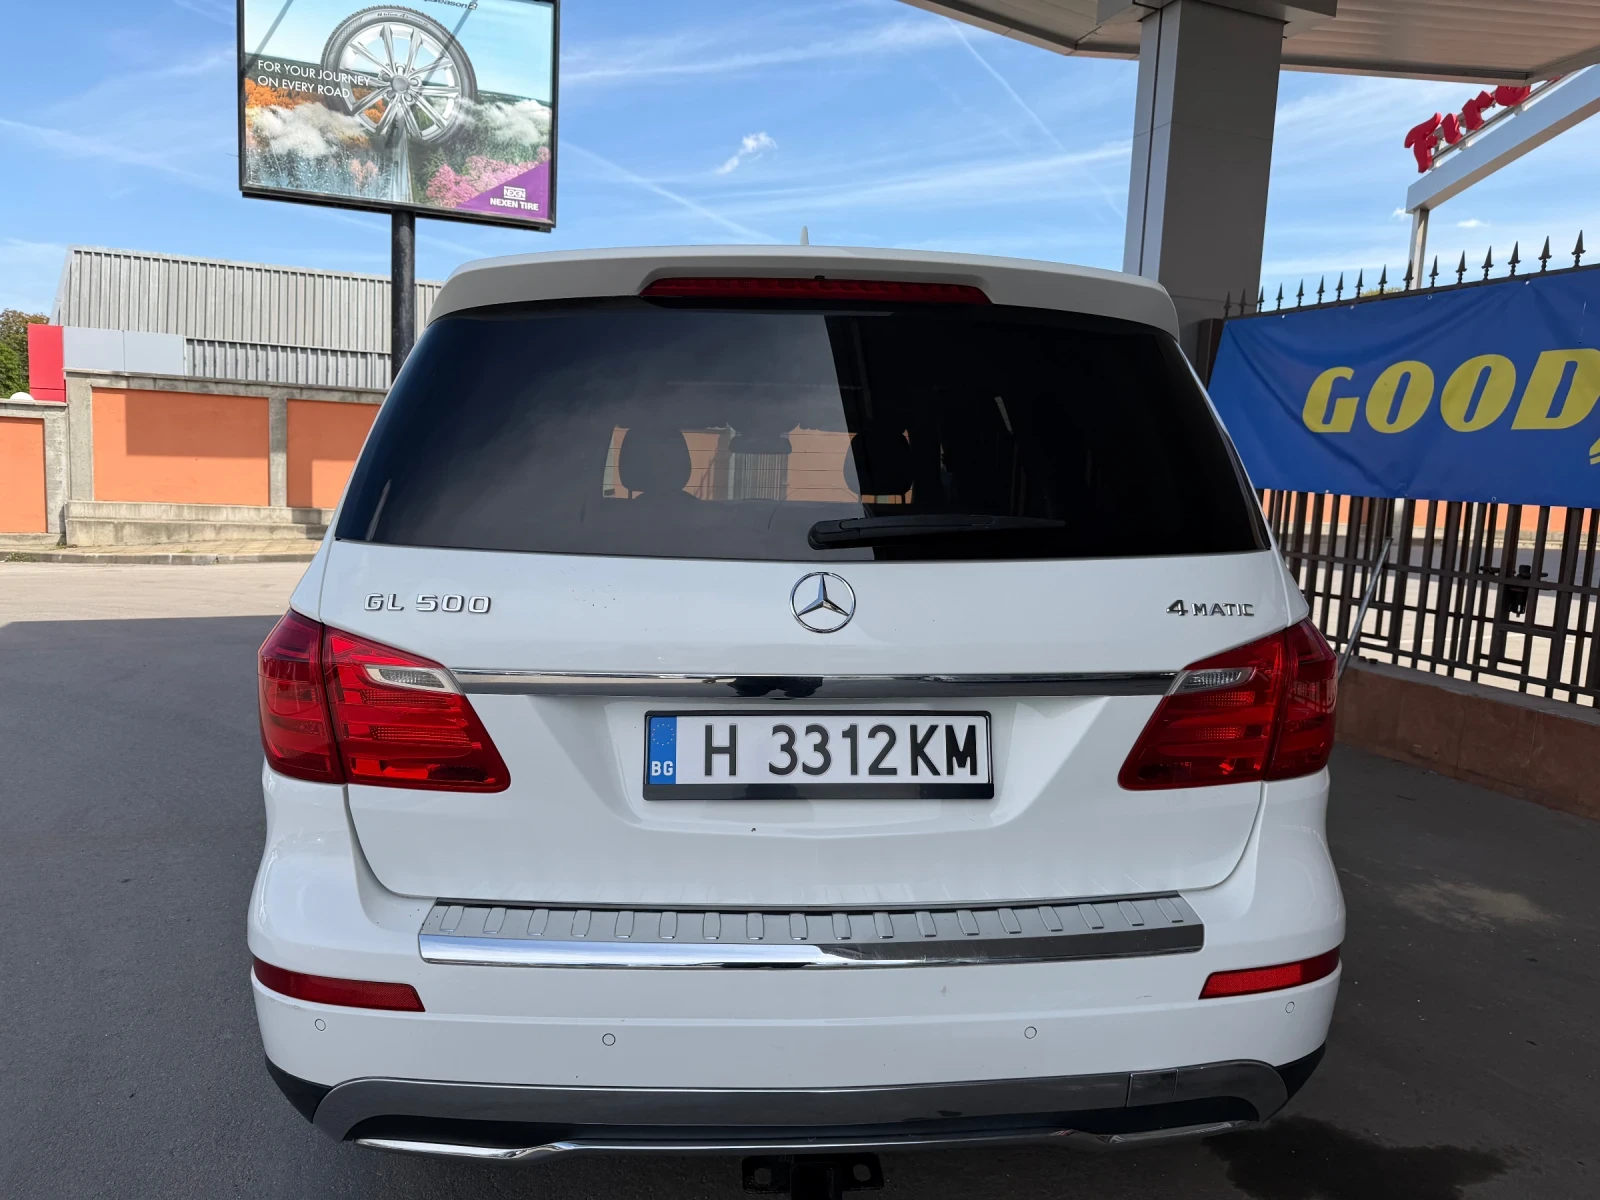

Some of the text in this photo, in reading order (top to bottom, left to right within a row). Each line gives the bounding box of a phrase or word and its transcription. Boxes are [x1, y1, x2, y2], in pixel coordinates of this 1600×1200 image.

[258, 60, 371, 87] FOR YOUR JOURNEY
[257, 75, 350, 98] ON EVERY ROAD
[489, 197, 539, 211] NEXEN TIRE
[364, 593, 492, 614] GL 500
[704, 724, 739, 777] H
[651, 760, 674, 777] BG
